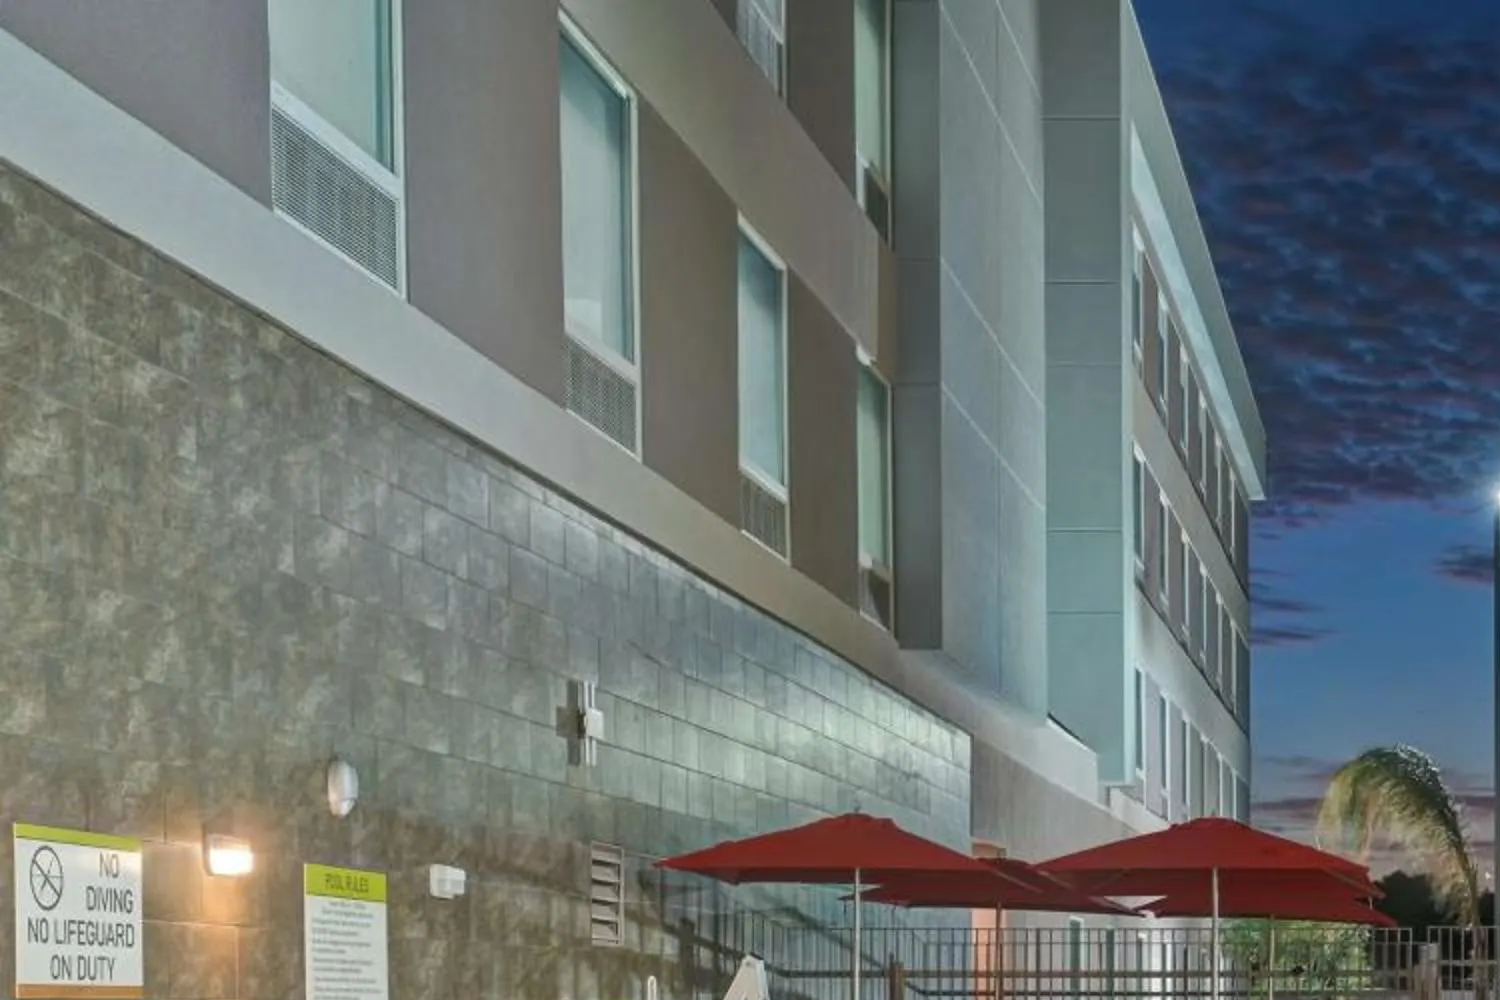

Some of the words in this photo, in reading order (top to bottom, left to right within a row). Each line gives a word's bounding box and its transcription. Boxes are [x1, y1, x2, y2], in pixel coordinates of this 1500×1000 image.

[99, 853, 119, 879] NO
[86, 885, 134, 914] DIVING
[27, 916, 49, 944] NO
[54, 919, 135, 948] LIFEGUARD
[50, 954, 71, 980] ON
[77, 955, 116, 982] DUTY
